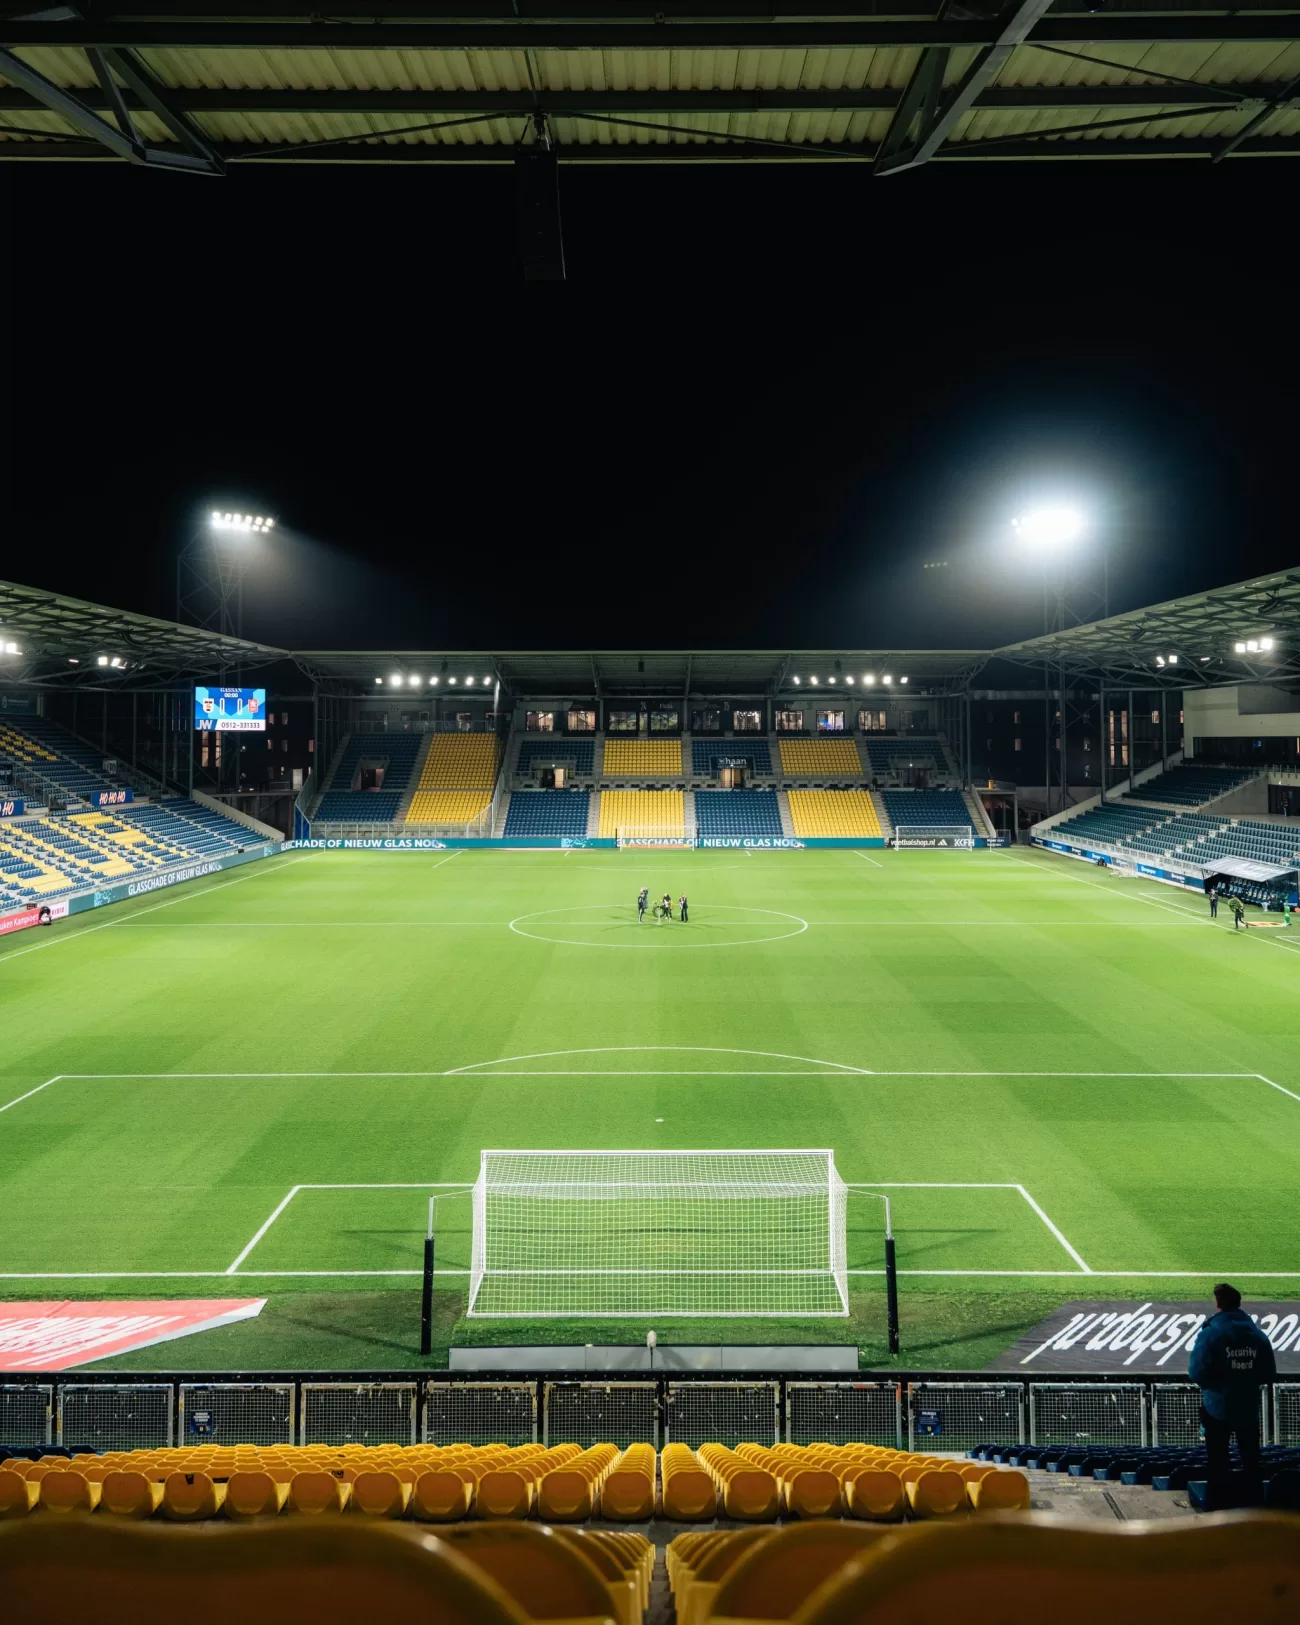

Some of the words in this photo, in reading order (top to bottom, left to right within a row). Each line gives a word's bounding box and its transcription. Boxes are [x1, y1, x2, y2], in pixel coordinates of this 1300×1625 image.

[221, 721, 260, 729] 0512-331333
[100, 792, 108, 805] HO
[109, 791, 117, 804] HO
[117, 790, 126, 803] HO
[2, 801, 14, 816] HO
[327, 839, 342, 848] OF
[344, 839, 382, 848] NIEUW
[384, 839, 412, 848] GLAS
[703, 838, 742, 847] NIEUW
[743, 838, 771, 847] GLAS
[128, 877, 168, 896] GLASSCHADE
[167, 873, 175, 884] OF
[176, 867, 196, 882] NIEUW
[195, 862, 208, 875] GLAS
[1225, 1346, 1257, 1359] Security
